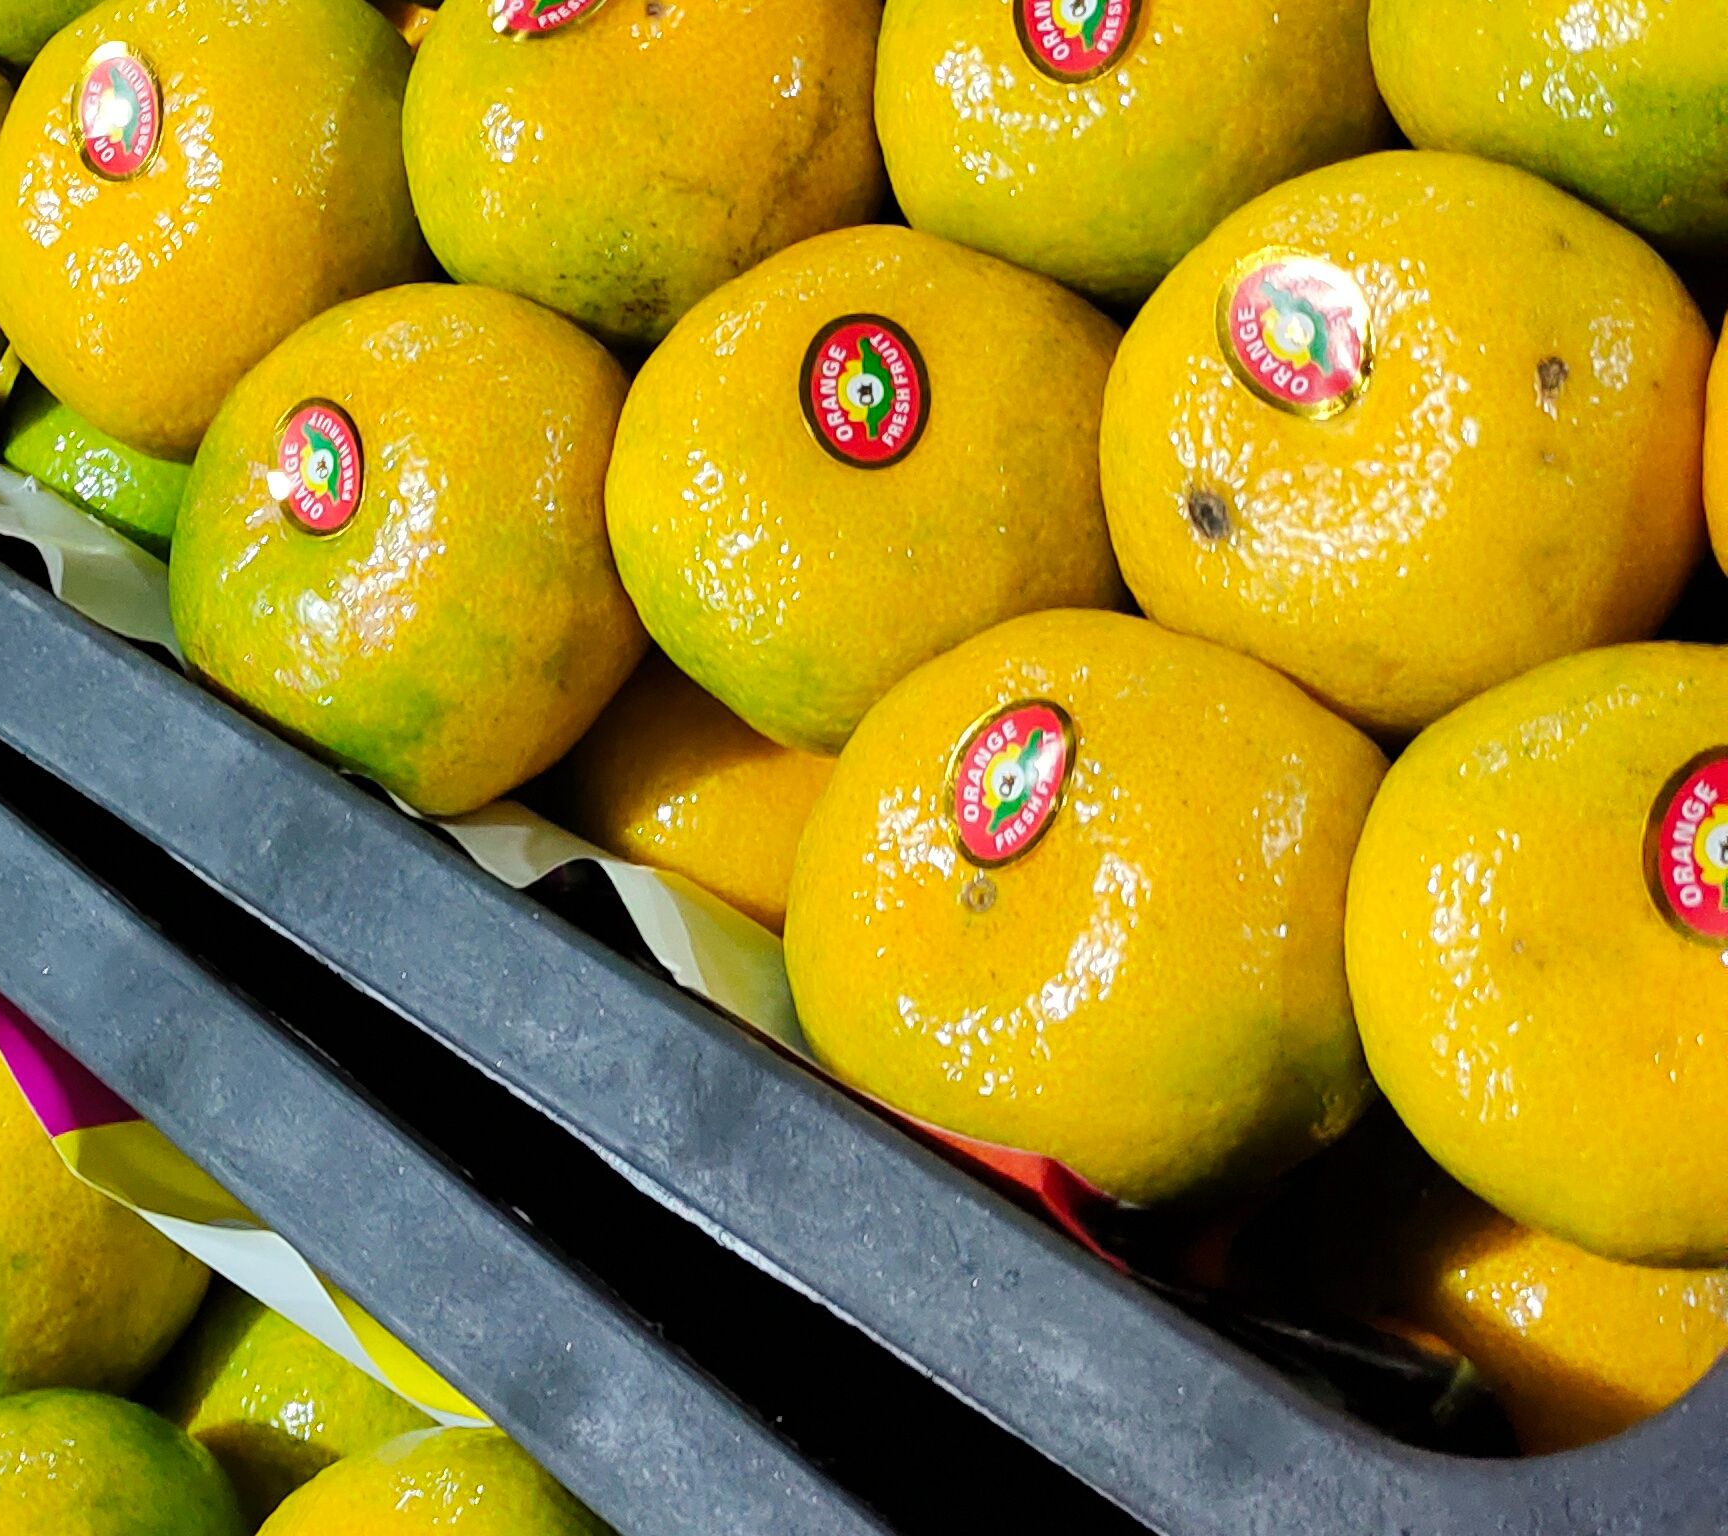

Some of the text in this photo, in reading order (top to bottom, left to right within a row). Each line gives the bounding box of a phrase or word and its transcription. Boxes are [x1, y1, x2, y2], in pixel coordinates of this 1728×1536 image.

[819, 343, 854, 442] ORANGE
[869, 332, 910, 448] FRESH FRUIT
[1237, 305, 1310, 395] ORANGE
[283, 441, 324, 521] ORANGE
[963, 719, 1018, 823] ORANGE
[994, 797, 1043, 852] FRESH
[1671, 779, 1719, 908] ORANGE
